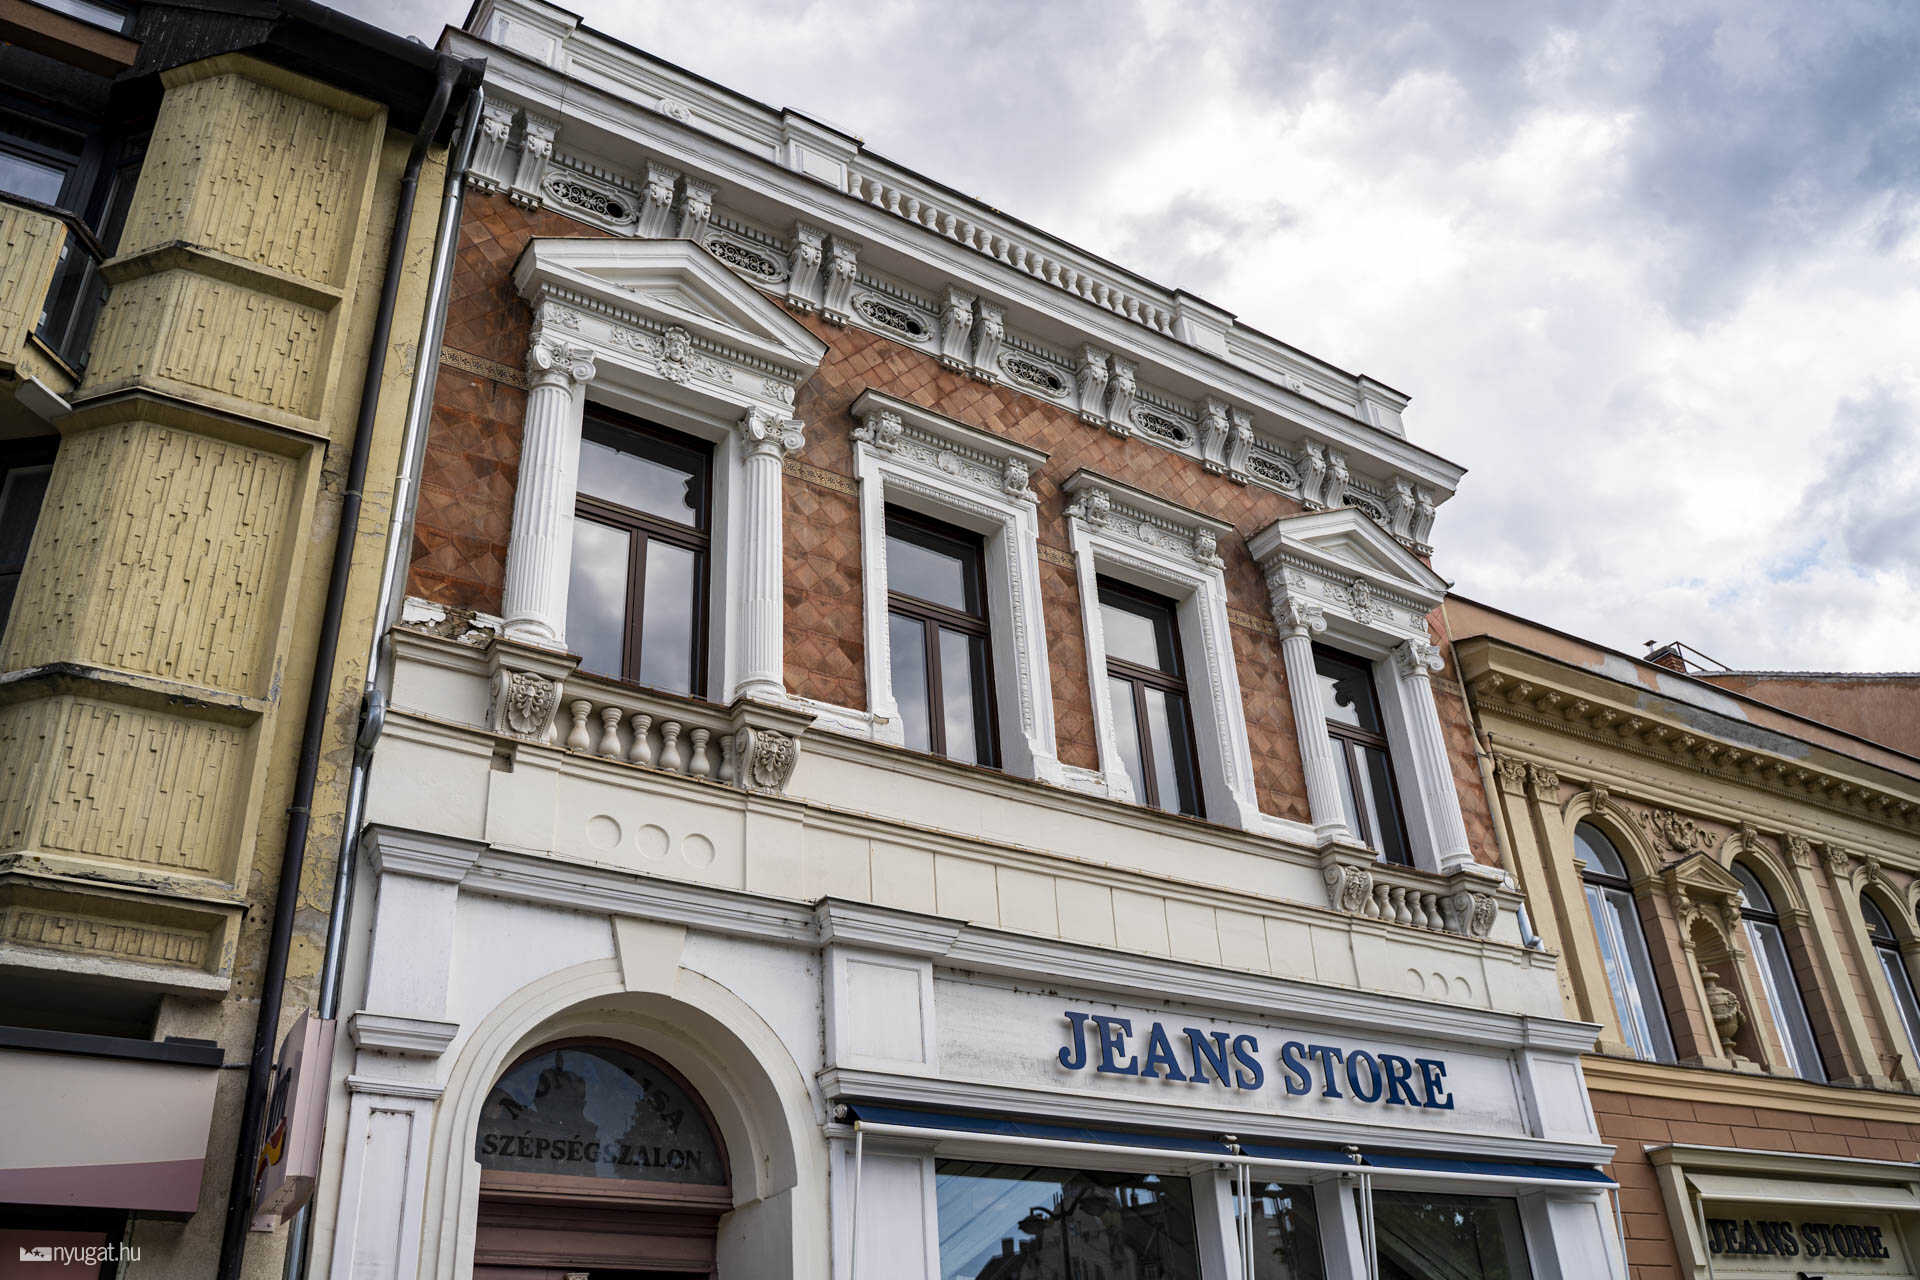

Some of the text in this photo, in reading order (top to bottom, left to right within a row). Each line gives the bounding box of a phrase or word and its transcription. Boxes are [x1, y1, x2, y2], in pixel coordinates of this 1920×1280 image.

[1057, 1010, 1455, 1110] JEANS STORE
[480, 1130, 702, 1171] SZÉPSÉGSZALON
[1706, 1218, 1889, 1259] JEANS STORE
